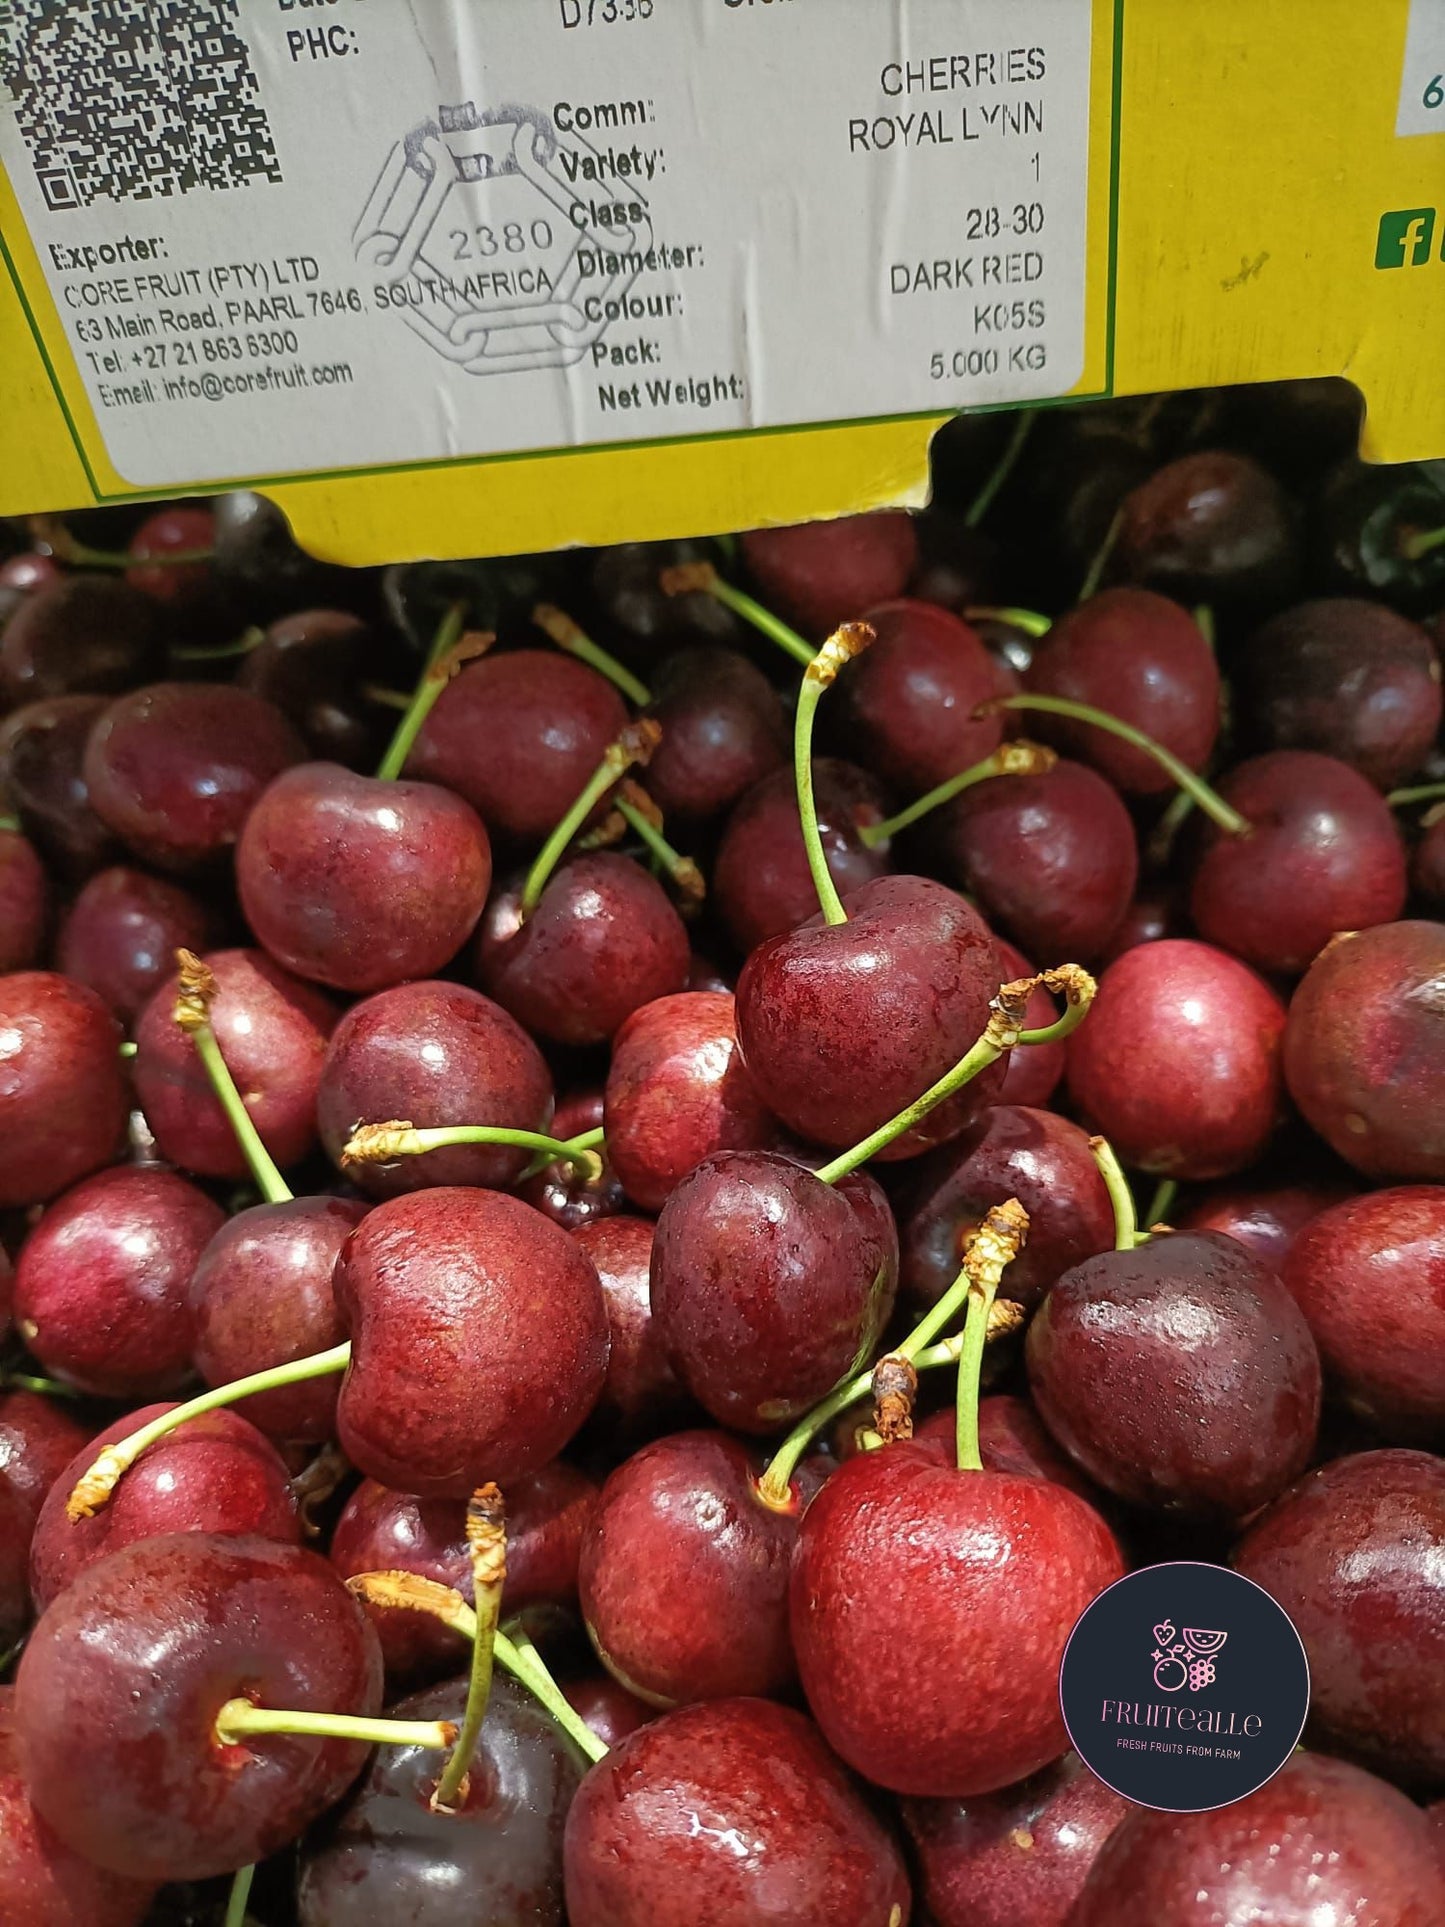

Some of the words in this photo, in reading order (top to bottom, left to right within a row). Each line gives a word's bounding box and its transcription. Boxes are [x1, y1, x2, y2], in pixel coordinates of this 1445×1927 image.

[286, 25, 360, 62] PHC:
[881, 47, 1046, 96] CHERRIES
[553, 100, 656, 132] Comm:
[849, 109, 954, 152] ROYAL
[963, 100, 1043, 141] LYNN
[559, 144, 666, 183] Variety:
[1031, 152, 1040, 183] 1
[449, 219, 554, 261] 2380
[966, 202, 1045, 241] 28-30
[48, 234, 169, 273] Exporter:
[577, 240, 704, 279] Diameter:
[890, 257, 974, 295] DARK
[982, 251, 1043, 286] RED
[64, 279, 134, 309] CORE
[134, 270, 202, 300] FRUIT
[208, 263, 270, 299] (PTY)
[273, 256, 319, 285] LTD
[75, 317, 103, 343] 63
[105, 313, 157, 340] Main
[159, 303, 224, 334] Road,
[226, 294, 305, 327] PAARL
[374, 277, 457, 310] SOUTH
[464, 267, 552, 300] AFRICA
[584, 292, 684, 323] Colour:
[131, 344, 167, 369] +27
[173, 341, 198, 366] 21
[202, 336, 243, 362] 863
[247, 330, 299, 358] 6300
[591, 336, 662, 369] Pack:
[930, 349, 999, 380] 5.000
[1009, 343, 1047, 373] KG
[163, 362, 354, 402] info@corefruit.com
[598, 382, 642, 412] Net
[645, 372, 745, 408] Weight:
